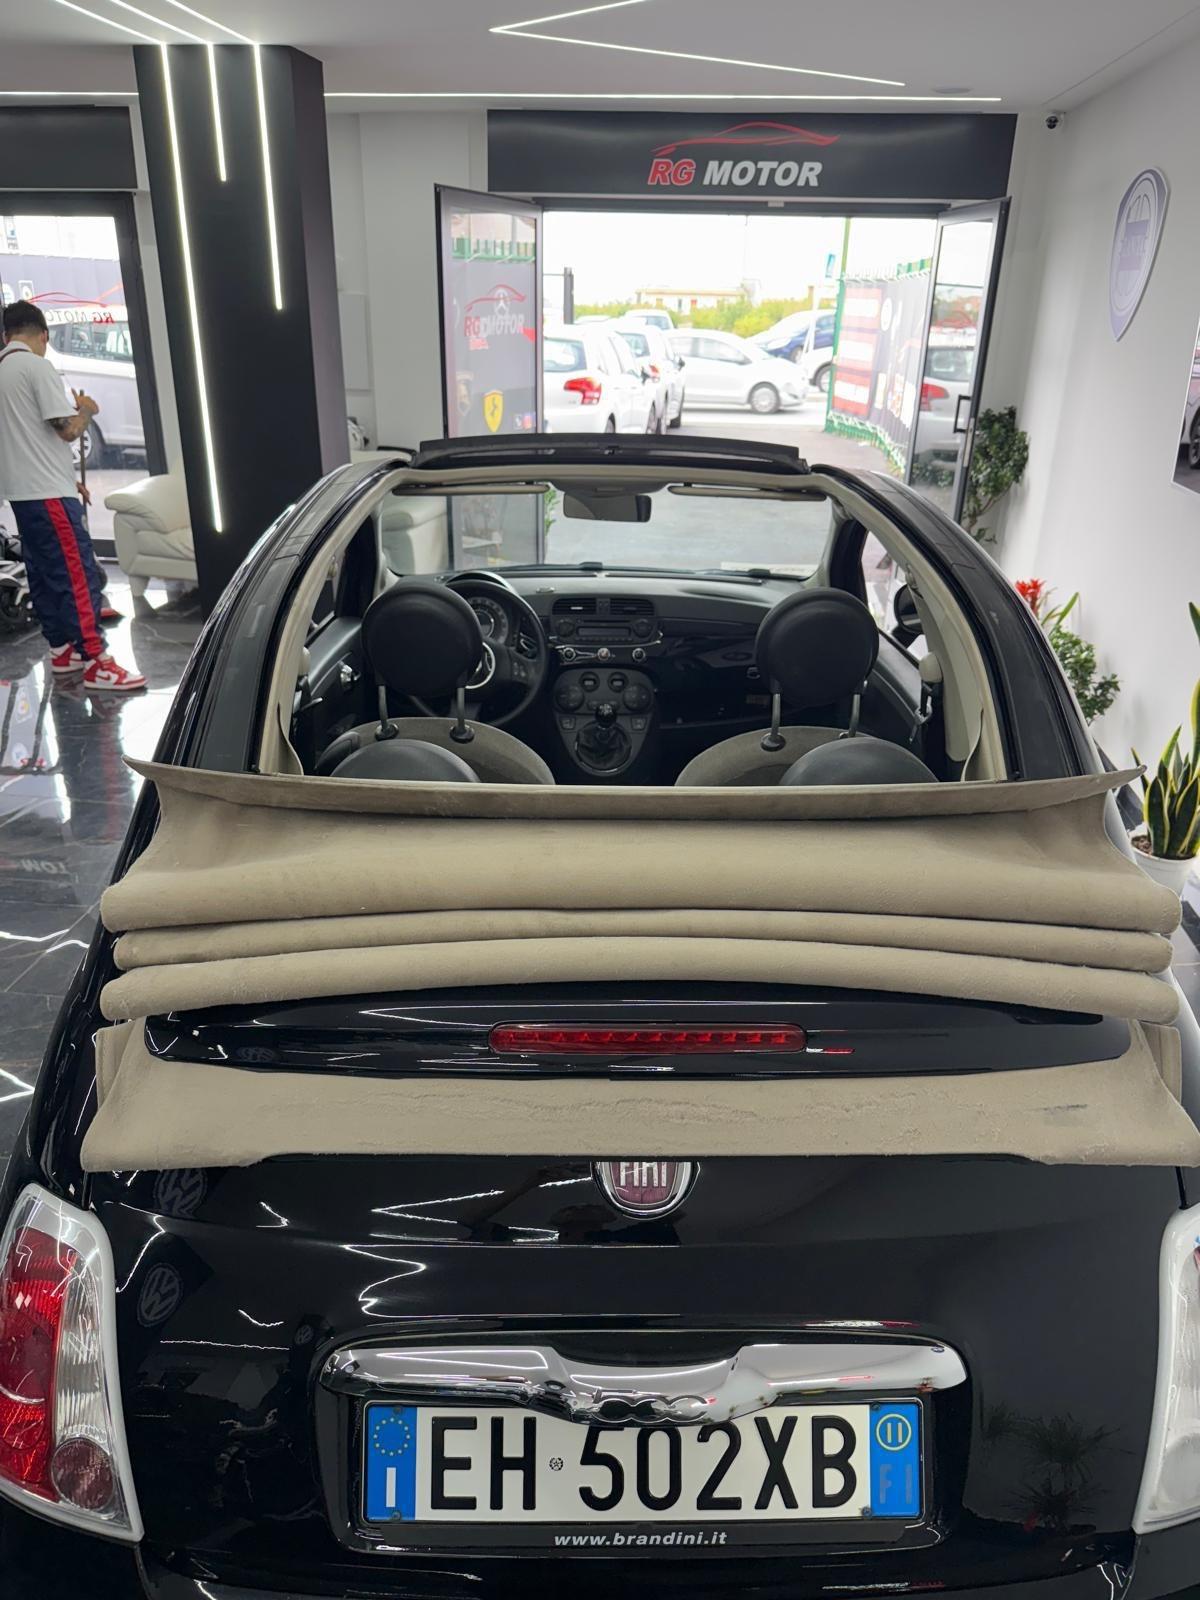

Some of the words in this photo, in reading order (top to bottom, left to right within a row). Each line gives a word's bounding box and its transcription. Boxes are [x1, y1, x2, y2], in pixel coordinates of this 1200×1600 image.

[647, 158, 696, 186] RG
[703, 160, 823, 187] MOTOR
[431, 1416, 537, 1511] EH
[579, 1415, 857, 1512] 502XB
[553, 1531, 728, 1546] www.brandini.it
